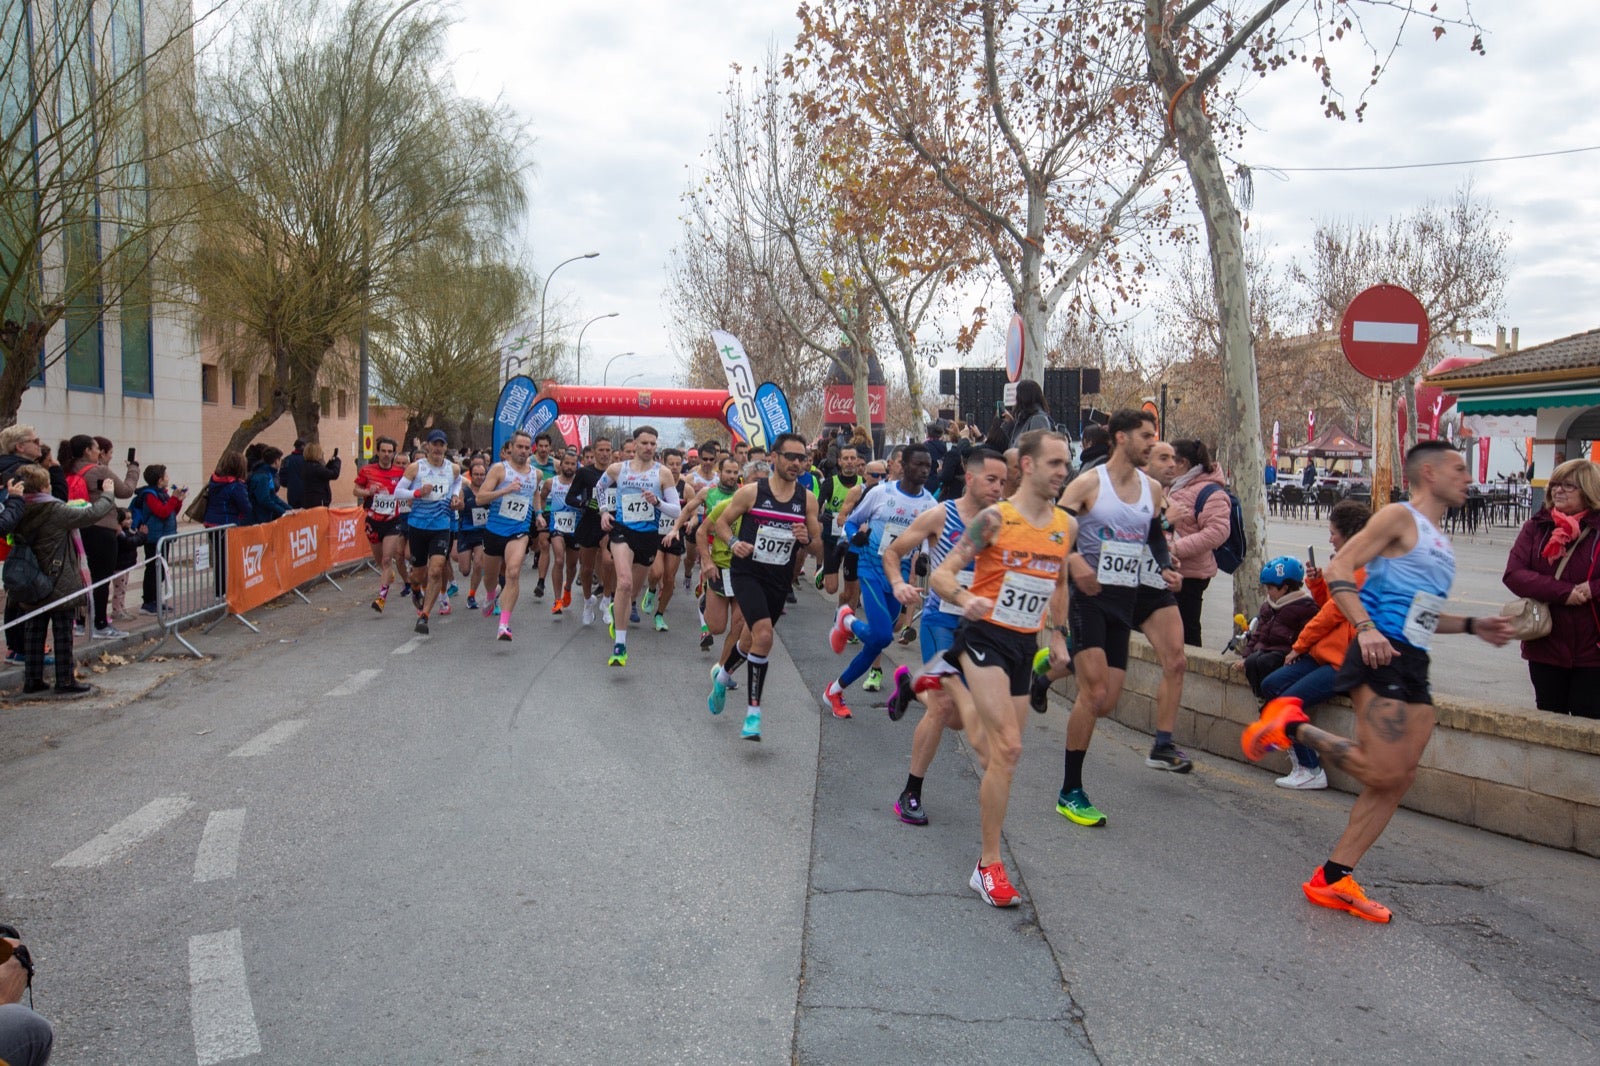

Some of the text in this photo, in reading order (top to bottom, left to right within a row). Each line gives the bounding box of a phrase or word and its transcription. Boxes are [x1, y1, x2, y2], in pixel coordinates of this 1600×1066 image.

[556, 395, 637, 405] AYUNTAMIENTO
[669, 399, 721, 407] ALBOLOTE
[374, 500, 395, 508] 3010
[507, 501, 525, 512] 127
[627, 502, 649, 512] 473
[558, 518, 573, 526] 670
[659, 519, 675, 527] 374
[757, 538, 792, 553] 3075
[1102, 555, 1139, 573] 3042
[1001, 589, 1048, 613] 3107
